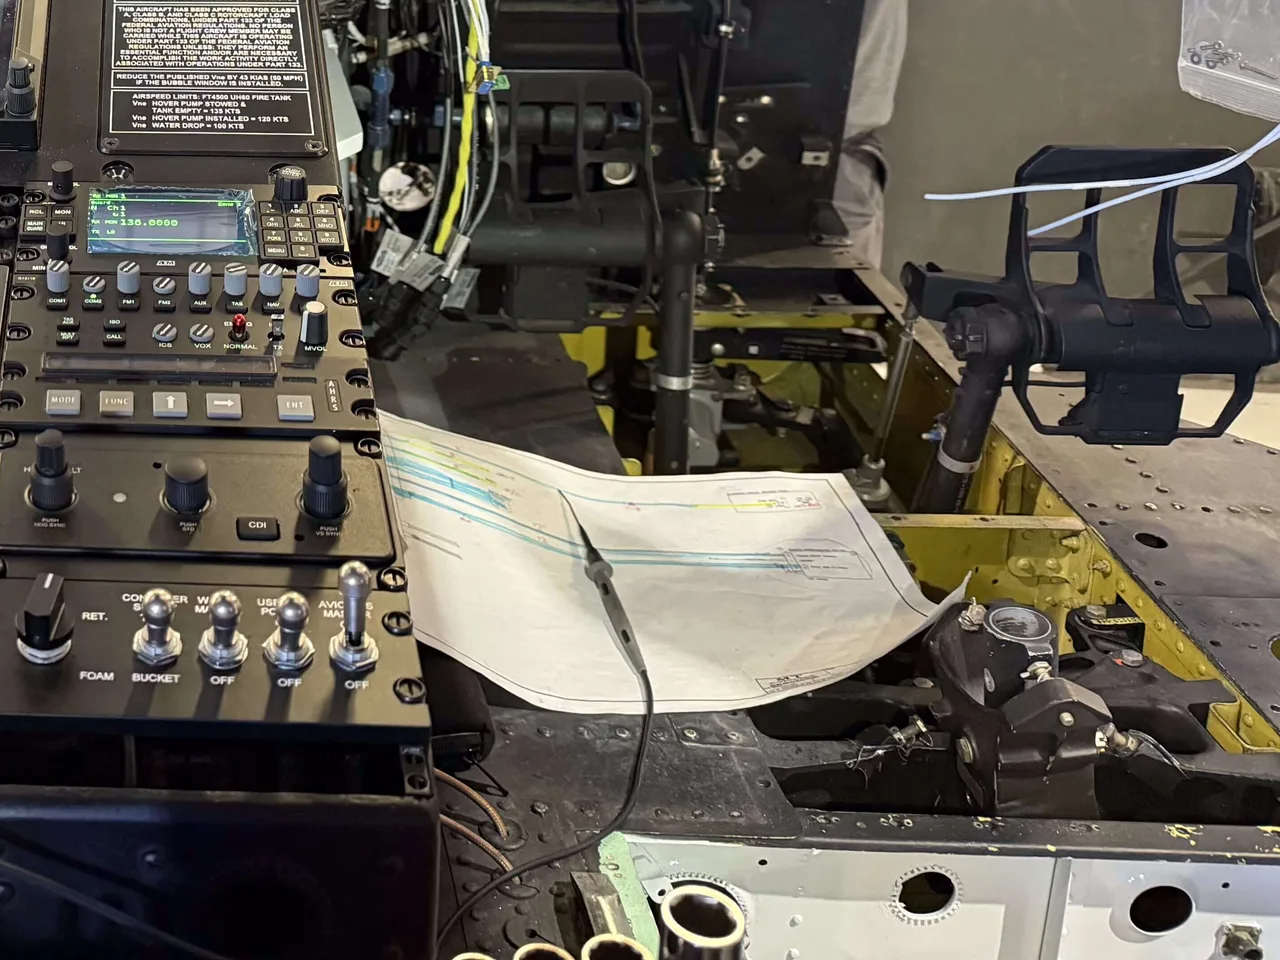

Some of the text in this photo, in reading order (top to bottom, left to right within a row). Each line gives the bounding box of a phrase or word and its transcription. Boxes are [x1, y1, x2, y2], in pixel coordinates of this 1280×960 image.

[51, 395, 76, 404] MODE
[286, 400, 304, 409] ENT
[248, 520, 267, 530] CDI
[80, 671, 114, 681] FOAM
[132, 673, 180, 684] BUCKET
